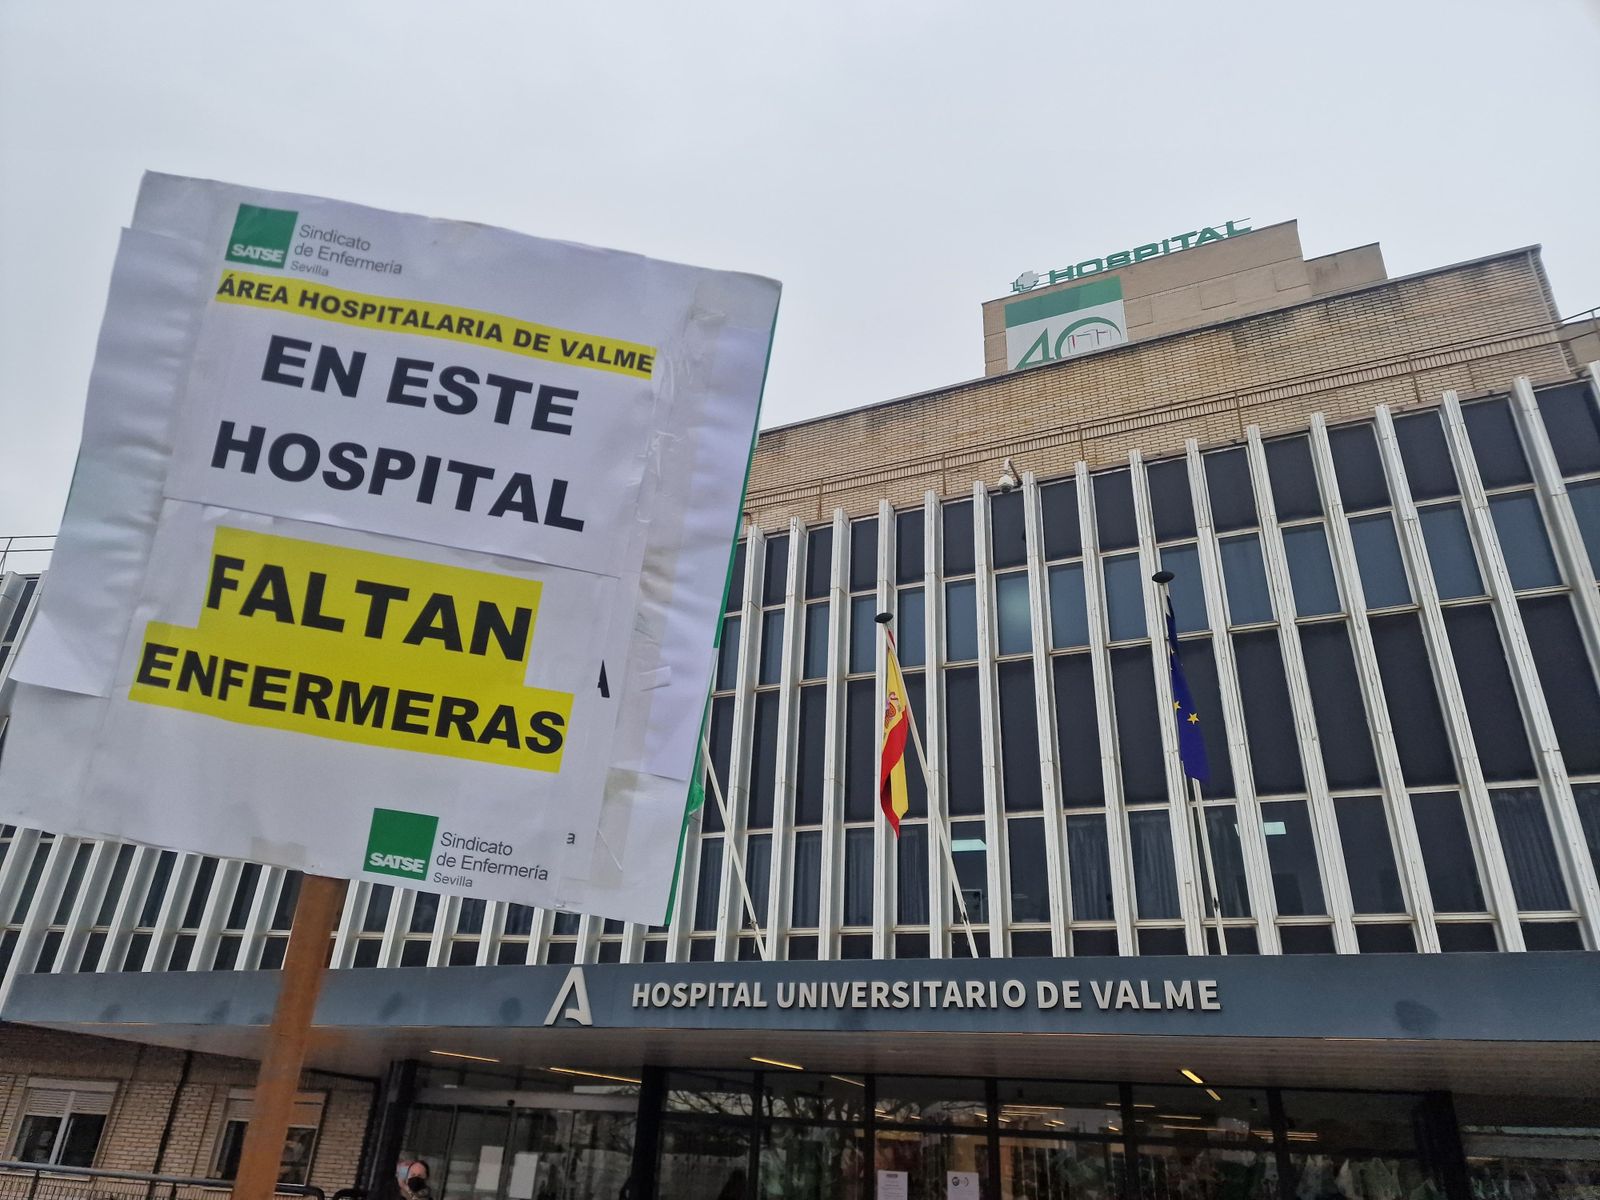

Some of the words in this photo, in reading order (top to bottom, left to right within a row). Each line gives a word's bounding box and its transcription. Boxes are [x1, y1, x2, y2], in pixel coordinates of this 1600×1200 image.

[294, 242, 315, 257] de
[299, 224, 372, 251] Sindicato
[231, 243, 285, 263] SATSE
[1049, 220, 1252, 285] HOSPITAL
[290, 260, 330, 277] Sevilla
[217, 273, 289, 304] ÁREA
[298, 289, 503, 342] HOSPITALARIA
[512, 327, 551, 353] DE
[560, 338, 655, 374] VALME
[261, 334, 367, 398] EN
[386, 356, 580, 436] ESTE
[210, 420, 585, 533] HOSPITAL
[205, 554, 533, 662] FALTAN
[136, 642, 566, 755] ENFERMERAS
[440, 831, 513, 856] Sindicato
[369, 852, 426, 874] SATSE
[436, 852, 457, 868] de
[460, 855, 549, 881] Enfermería
[433, 872, 473, 888] Sevilla
[631, 981, 767, 1008] HOSPITAL
[776, 979, 1026, 1009] UNIVERSITARIO
[1036, 980, 1083, 1010] DE
[1089, 980, 1221, 1011] VALME
